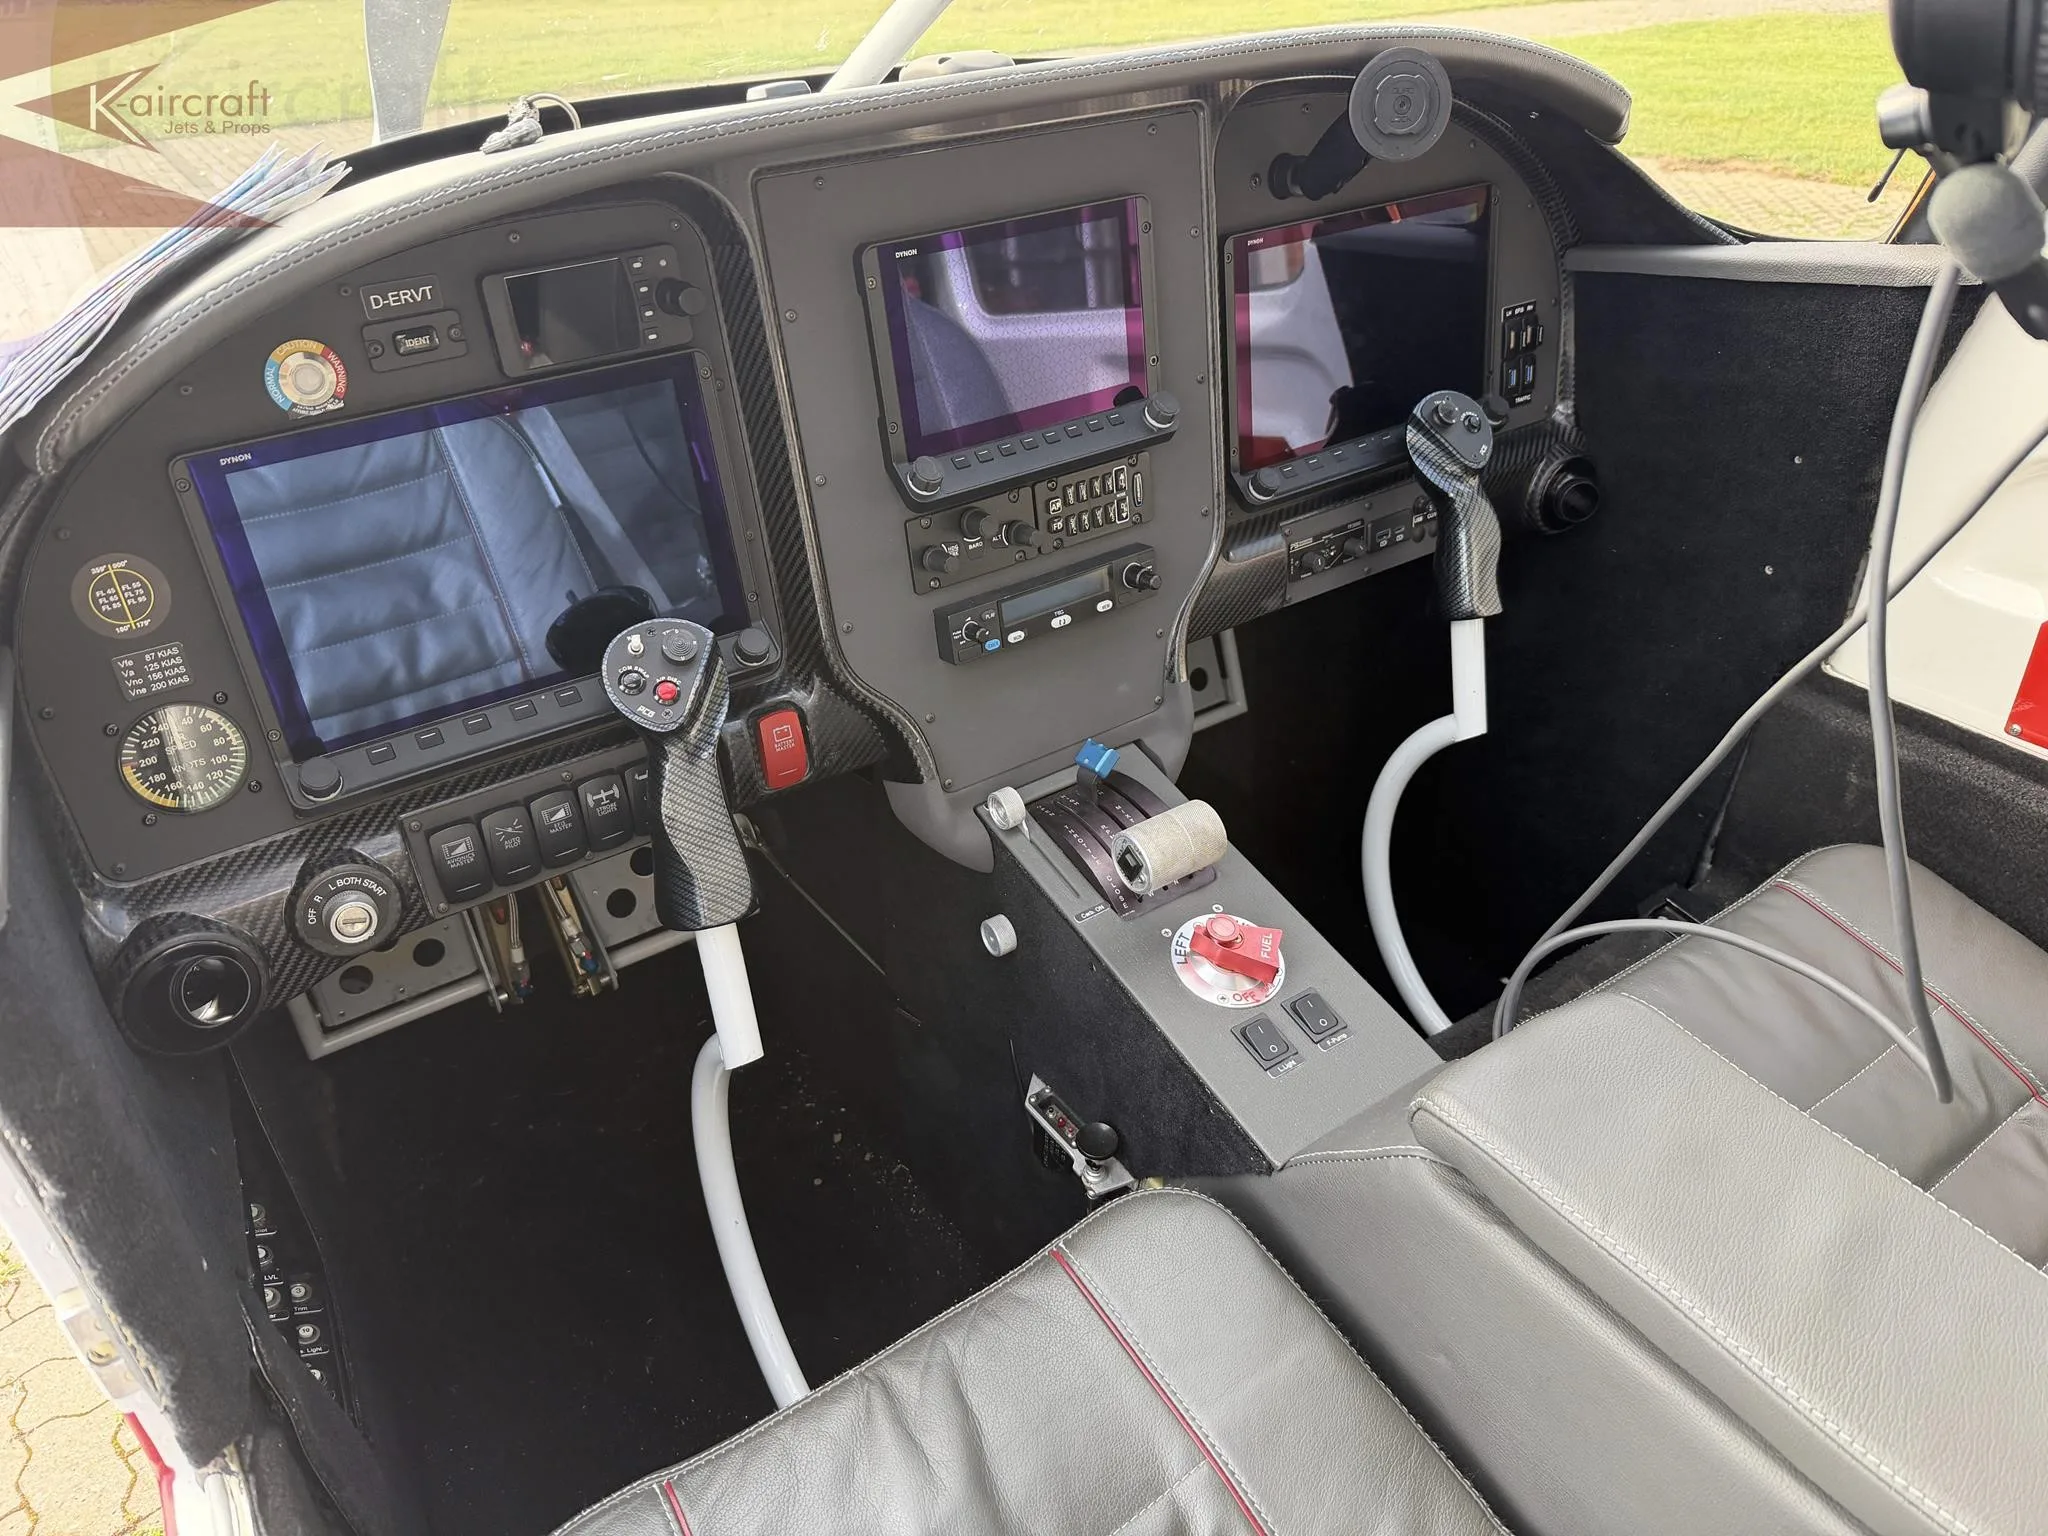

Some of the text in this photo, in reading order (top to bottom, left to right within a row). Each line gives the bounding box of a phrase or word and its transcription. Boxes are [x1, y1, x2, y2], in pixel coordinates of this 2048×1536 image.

[369, 285, 433, 310] D-ERVT
[276, 341, 318, 355] CAUTION
[405, 335, 431, 348] IDENT
[326, 350, 346, 394] WARNING
[265, 366, 287, 404] NORMAL
[219, 452, 252, 466] DYNON
[1053, 521, 1063, 531] FD
[144, 652, 156, 662] 87
[157, 646, 180, 658] KIAS
[121, 656, 183, 678] Va 125 KIAS
[125, 665, 187, 688] Vno 156 KIAS
[128, 674, 190, 697] Vne 200 KIAS
[181, 716, 193, 726] 40
[150, 722, 169, 735] 240
[200, 723, 213, 733] 60
[141, 737, 161, 750] 220
[213, 736, 226, 747] 80
[139, 755, 158, 768] 200
[210, 754, 228, 765] 100
[148, 771, 167, 784] 180
[205, 768, 224, 781] 120
[164, 781, 182, 793] 160
[187, 781, 205, 793] 140
[549, 822, 573, 834] MASTER
[504, 836, 521, 846] AUTO
[505, 840, 521, 850] PILOT
[447, 851, 476, 865] AVIONICS
[450, 857, 475, 869] MASTER
[328, 876, 388, 897] L BOTH START
[1106, 875, 1129, 909] CLOSE
[313, 894, 324, 903] R
[308, 907, 317, 925] OFF
[1174, 931, 1191, 965] LEFT
[1260, 932, 1273, 958] FUEL
[1232, 990, 1257, 1004] OFF
